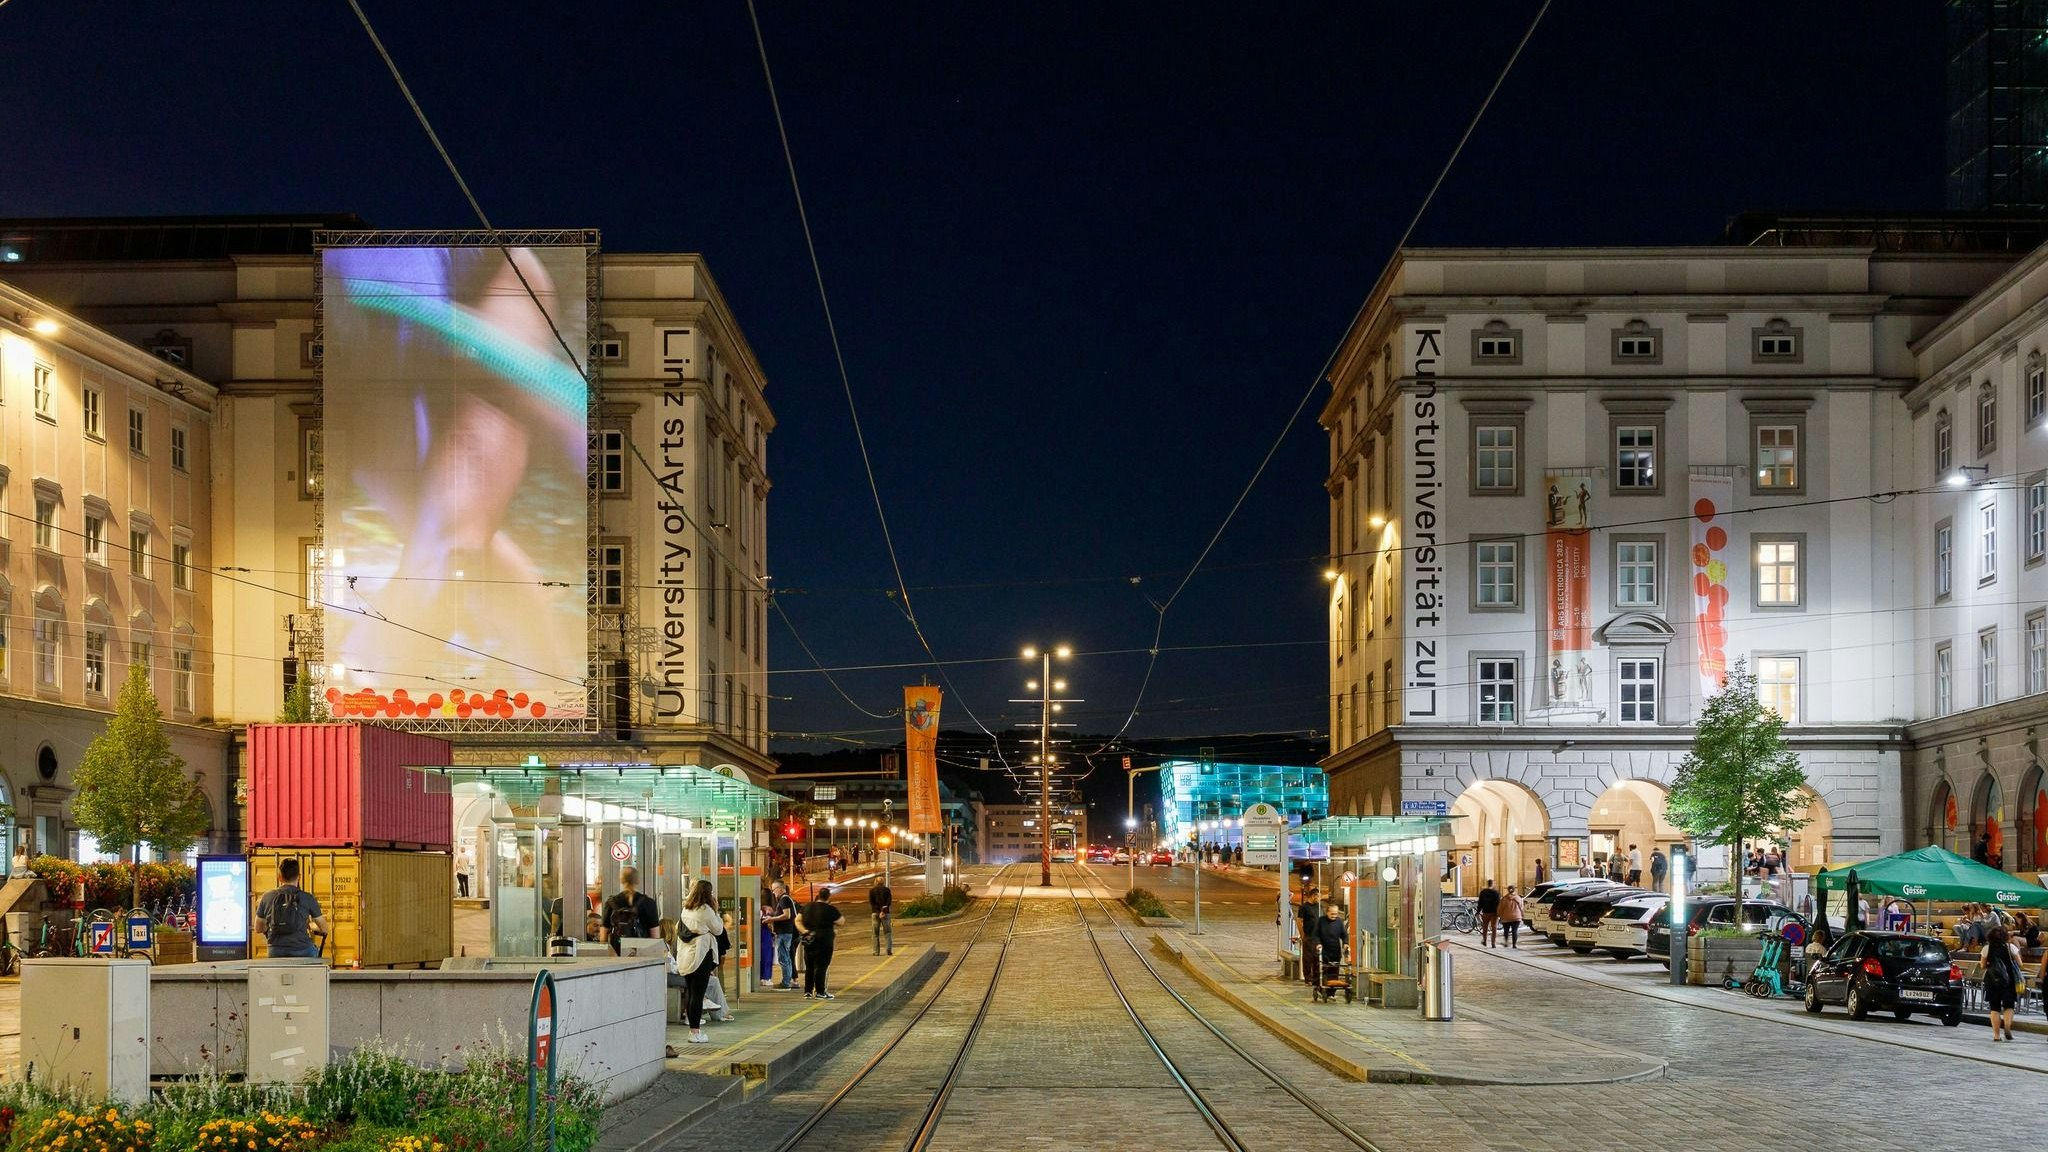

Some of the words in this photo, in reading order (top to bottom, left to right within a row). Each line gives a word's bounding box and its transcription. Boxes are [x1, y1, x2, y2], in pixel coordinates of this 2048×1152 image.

[662, 330, 690, 407] Linz
[657, 418, 685, 494] Arts
[1415, 328, 1443, 628] Kunstuniversität
[657, 501, 685, 535] of
[1556, 558, 1565, 610] ELECTRONICA
[657, 541, 692, 717] University
[1557, 611, 1565, 626] ARS
[1408, 640, 1436, 717] Linz
[1902, 884, 1928, 896] Gösser
[1996, 891, 2021, 902] Gösser
[132, 928, 147, 938] Taxi
